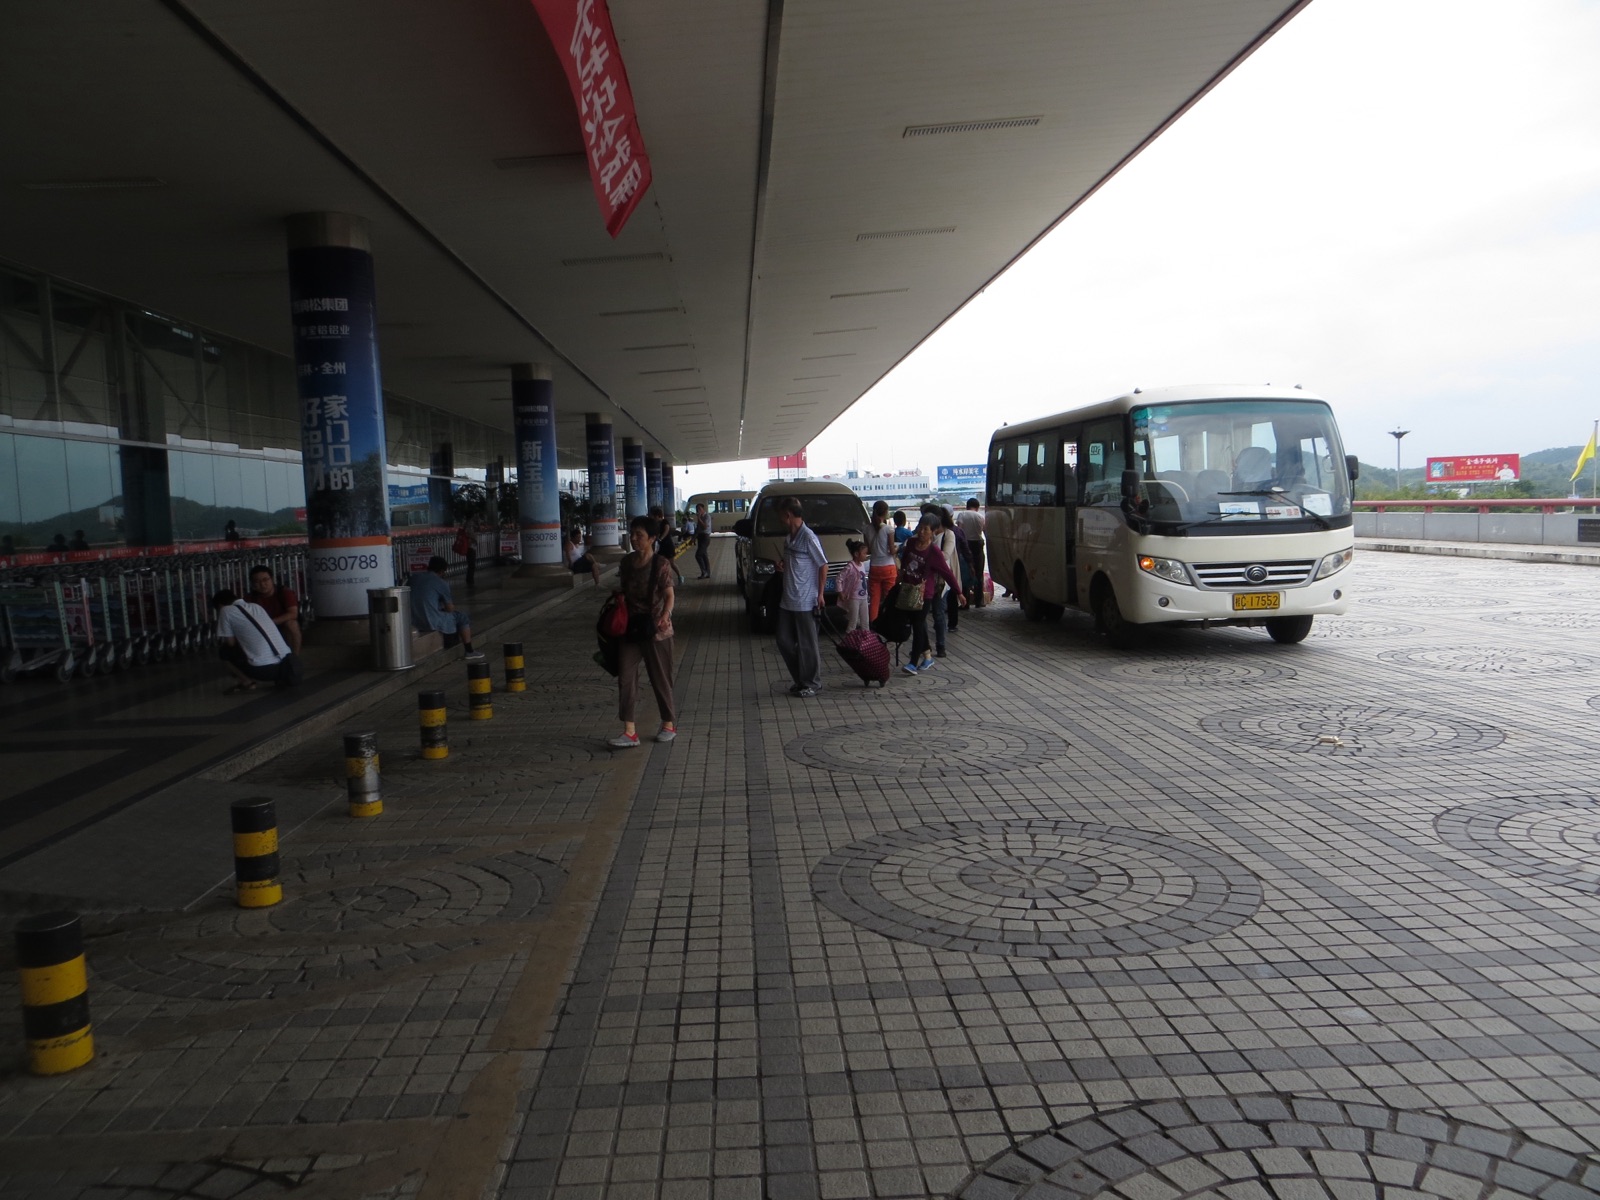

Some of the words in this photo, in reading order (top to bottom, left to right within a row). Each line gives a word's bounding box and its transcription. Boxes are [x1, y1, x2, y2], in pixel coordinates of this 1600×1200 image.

[323, 395, 354, 491] 家门口的
[314, 554, 379, 572] 5630788
